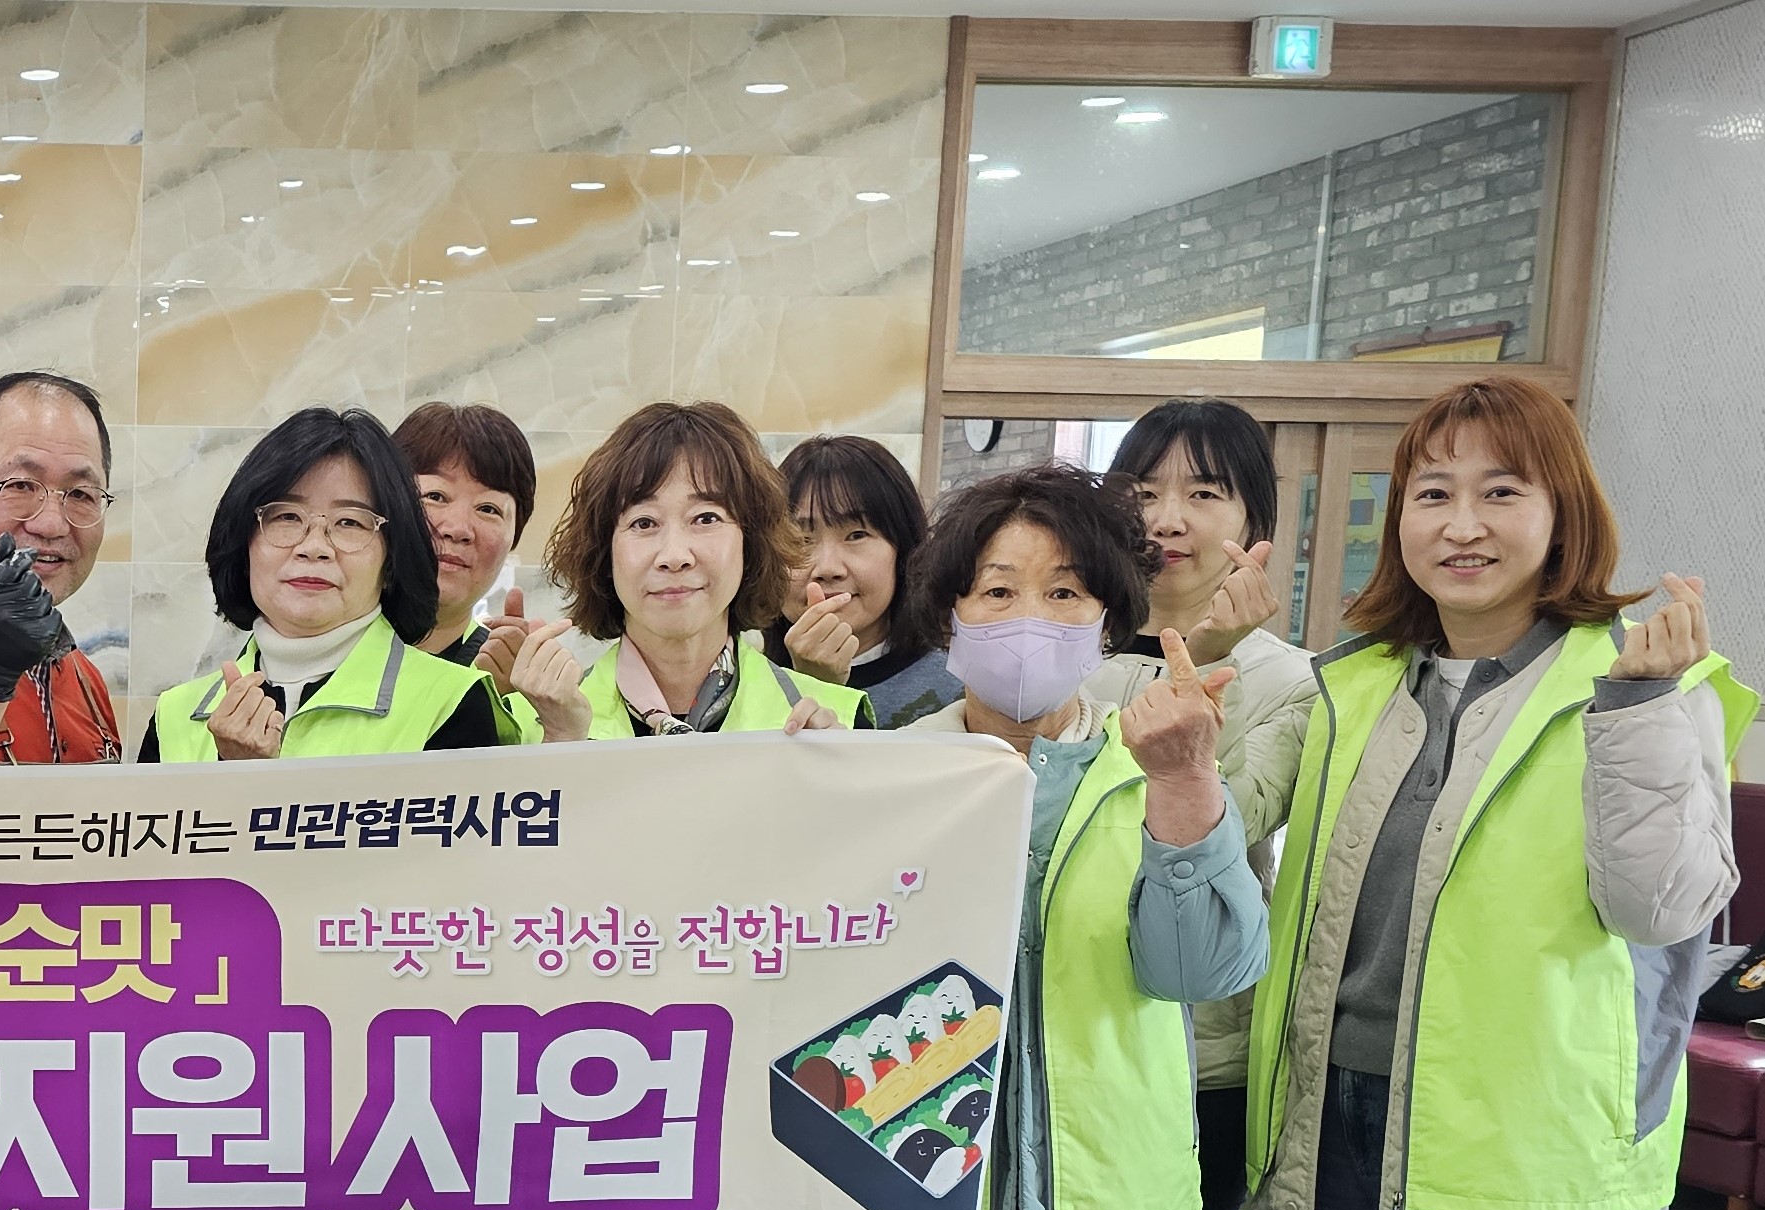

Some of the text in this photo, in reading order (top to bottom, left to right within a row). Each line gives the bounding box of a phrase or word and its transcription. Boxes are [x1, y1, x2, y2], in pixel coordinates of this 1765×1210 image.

[248, 789, 562, 852] 민관협력사업
[318, 903, 896, 974] 따뜻한 정성을 전합니다
[346, 1028, 709, 1206] 사업
